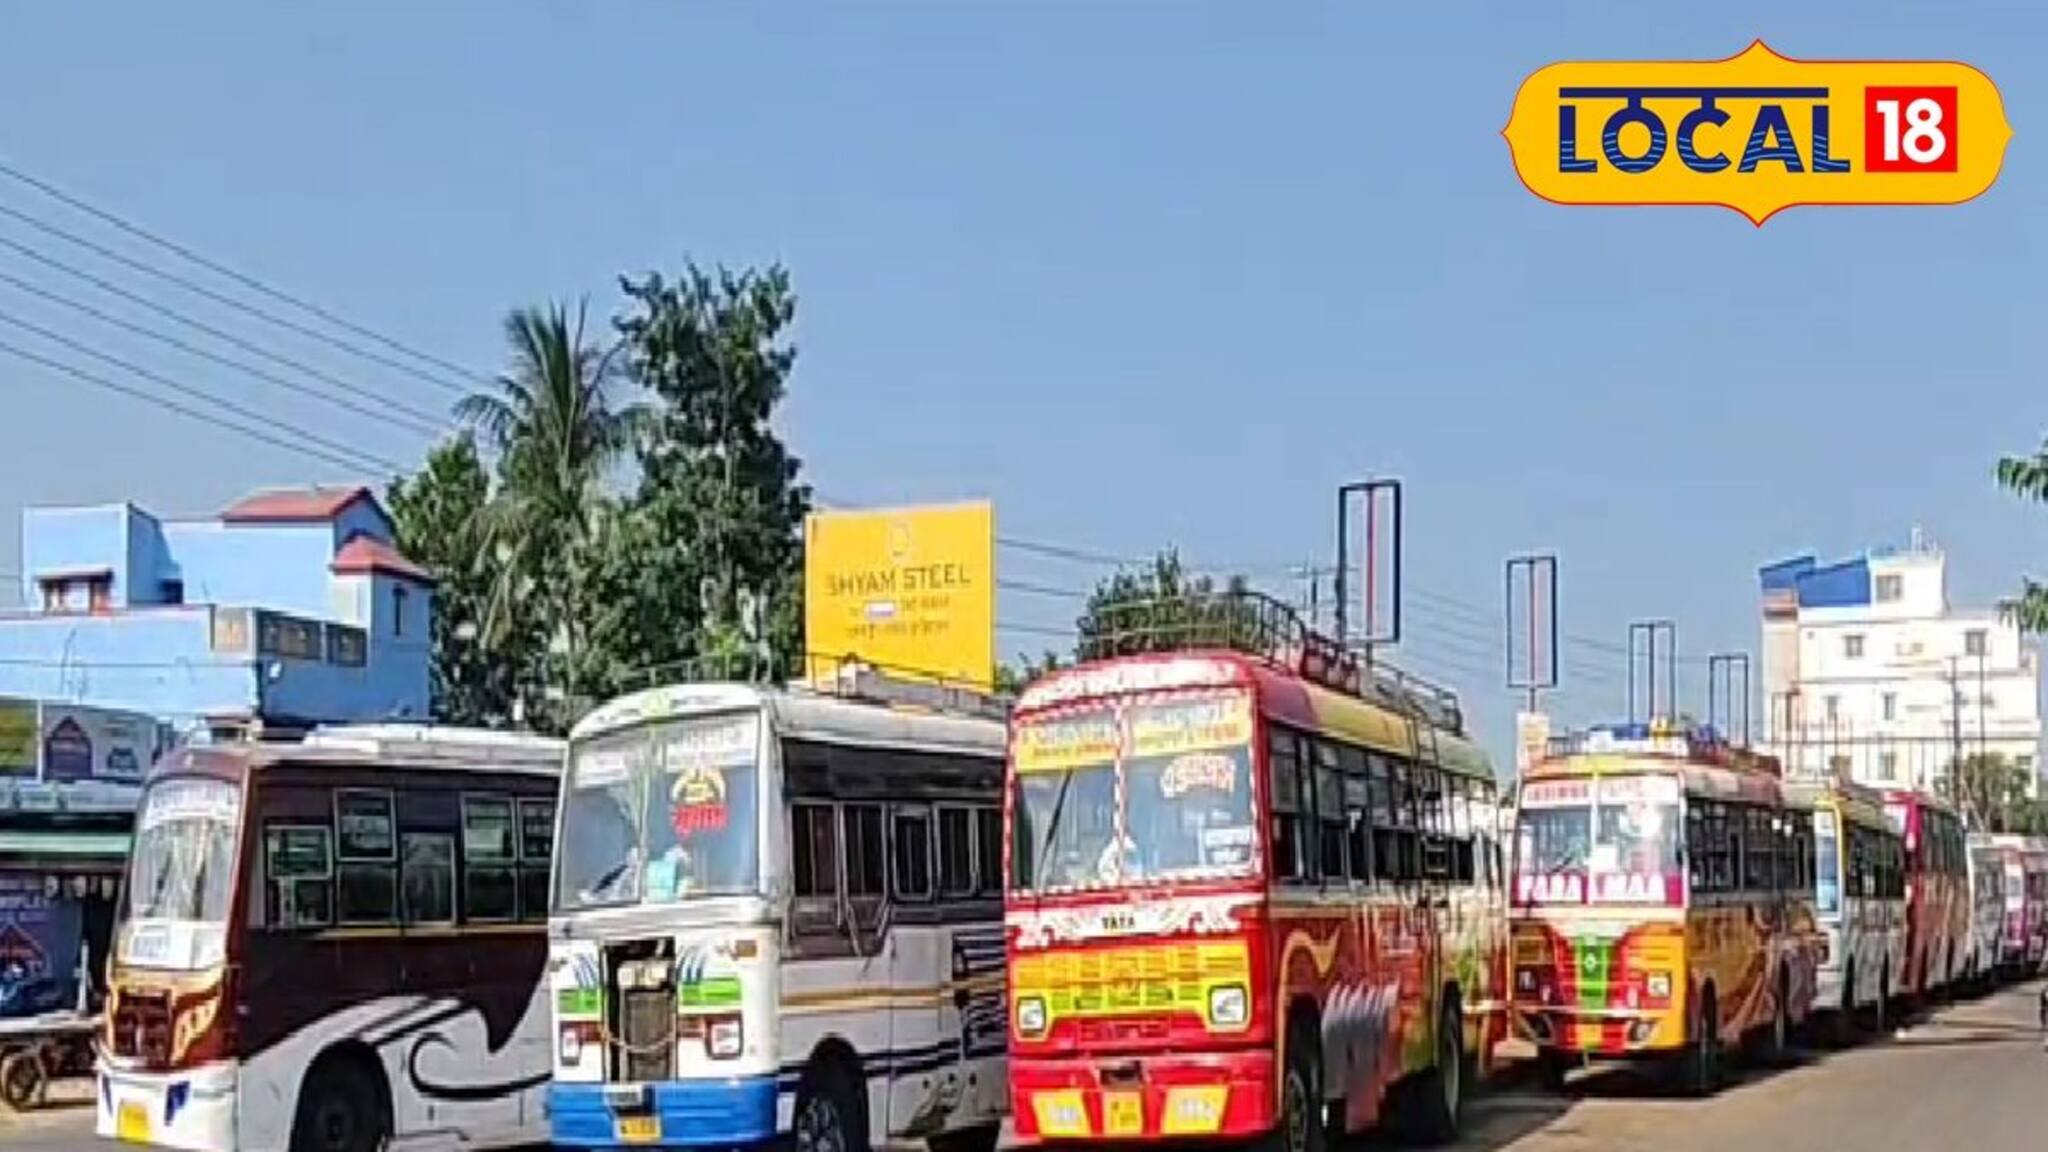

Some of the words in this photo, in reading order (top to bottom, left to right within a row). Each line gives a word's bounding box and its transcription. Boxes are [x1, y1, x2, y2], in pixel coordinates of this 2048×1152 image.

[826, 568, 896, 596] SHYAM
[903, 563, 971, 590] STEEL
[1101, 915, 1136, 930] TATA
